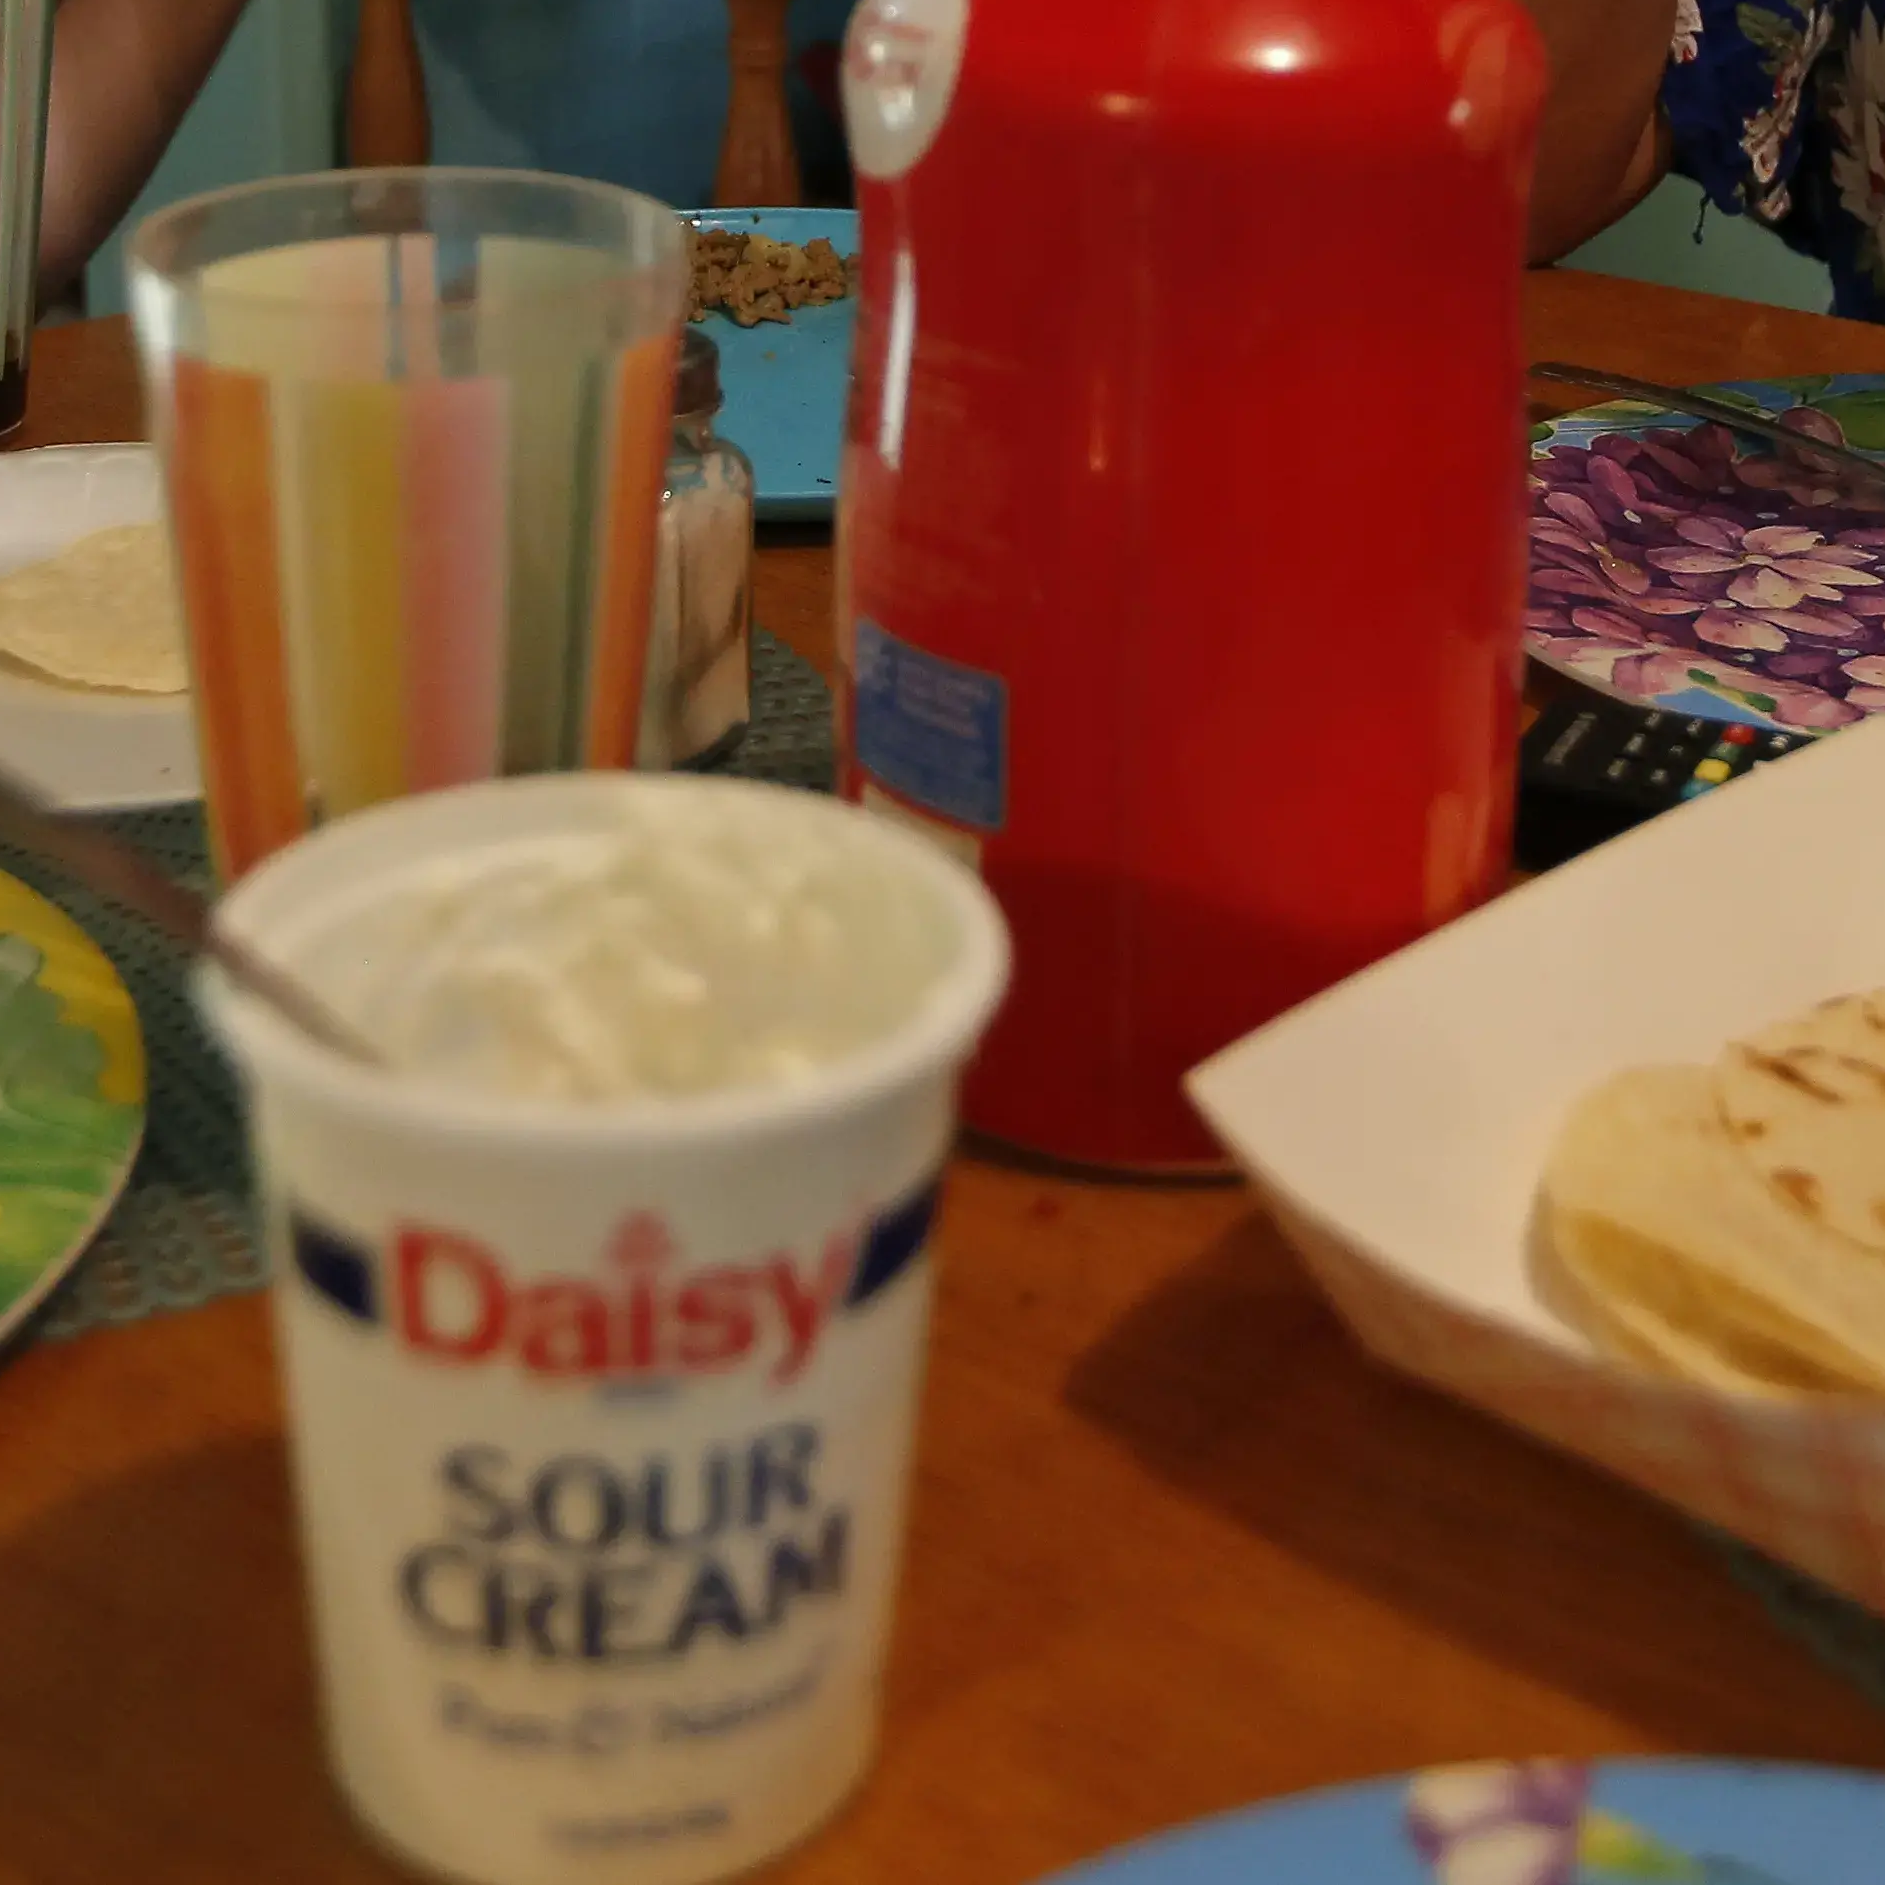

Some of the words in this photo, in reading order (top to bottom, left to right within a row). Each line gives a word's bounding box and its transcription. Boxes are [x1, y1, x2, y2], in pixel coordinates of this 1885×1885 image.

[392, 1208, 858, 1392] Daisy
[441, 1421, 818, 1546] SOUR
[401, 1513, 849, 1664] CREAM
